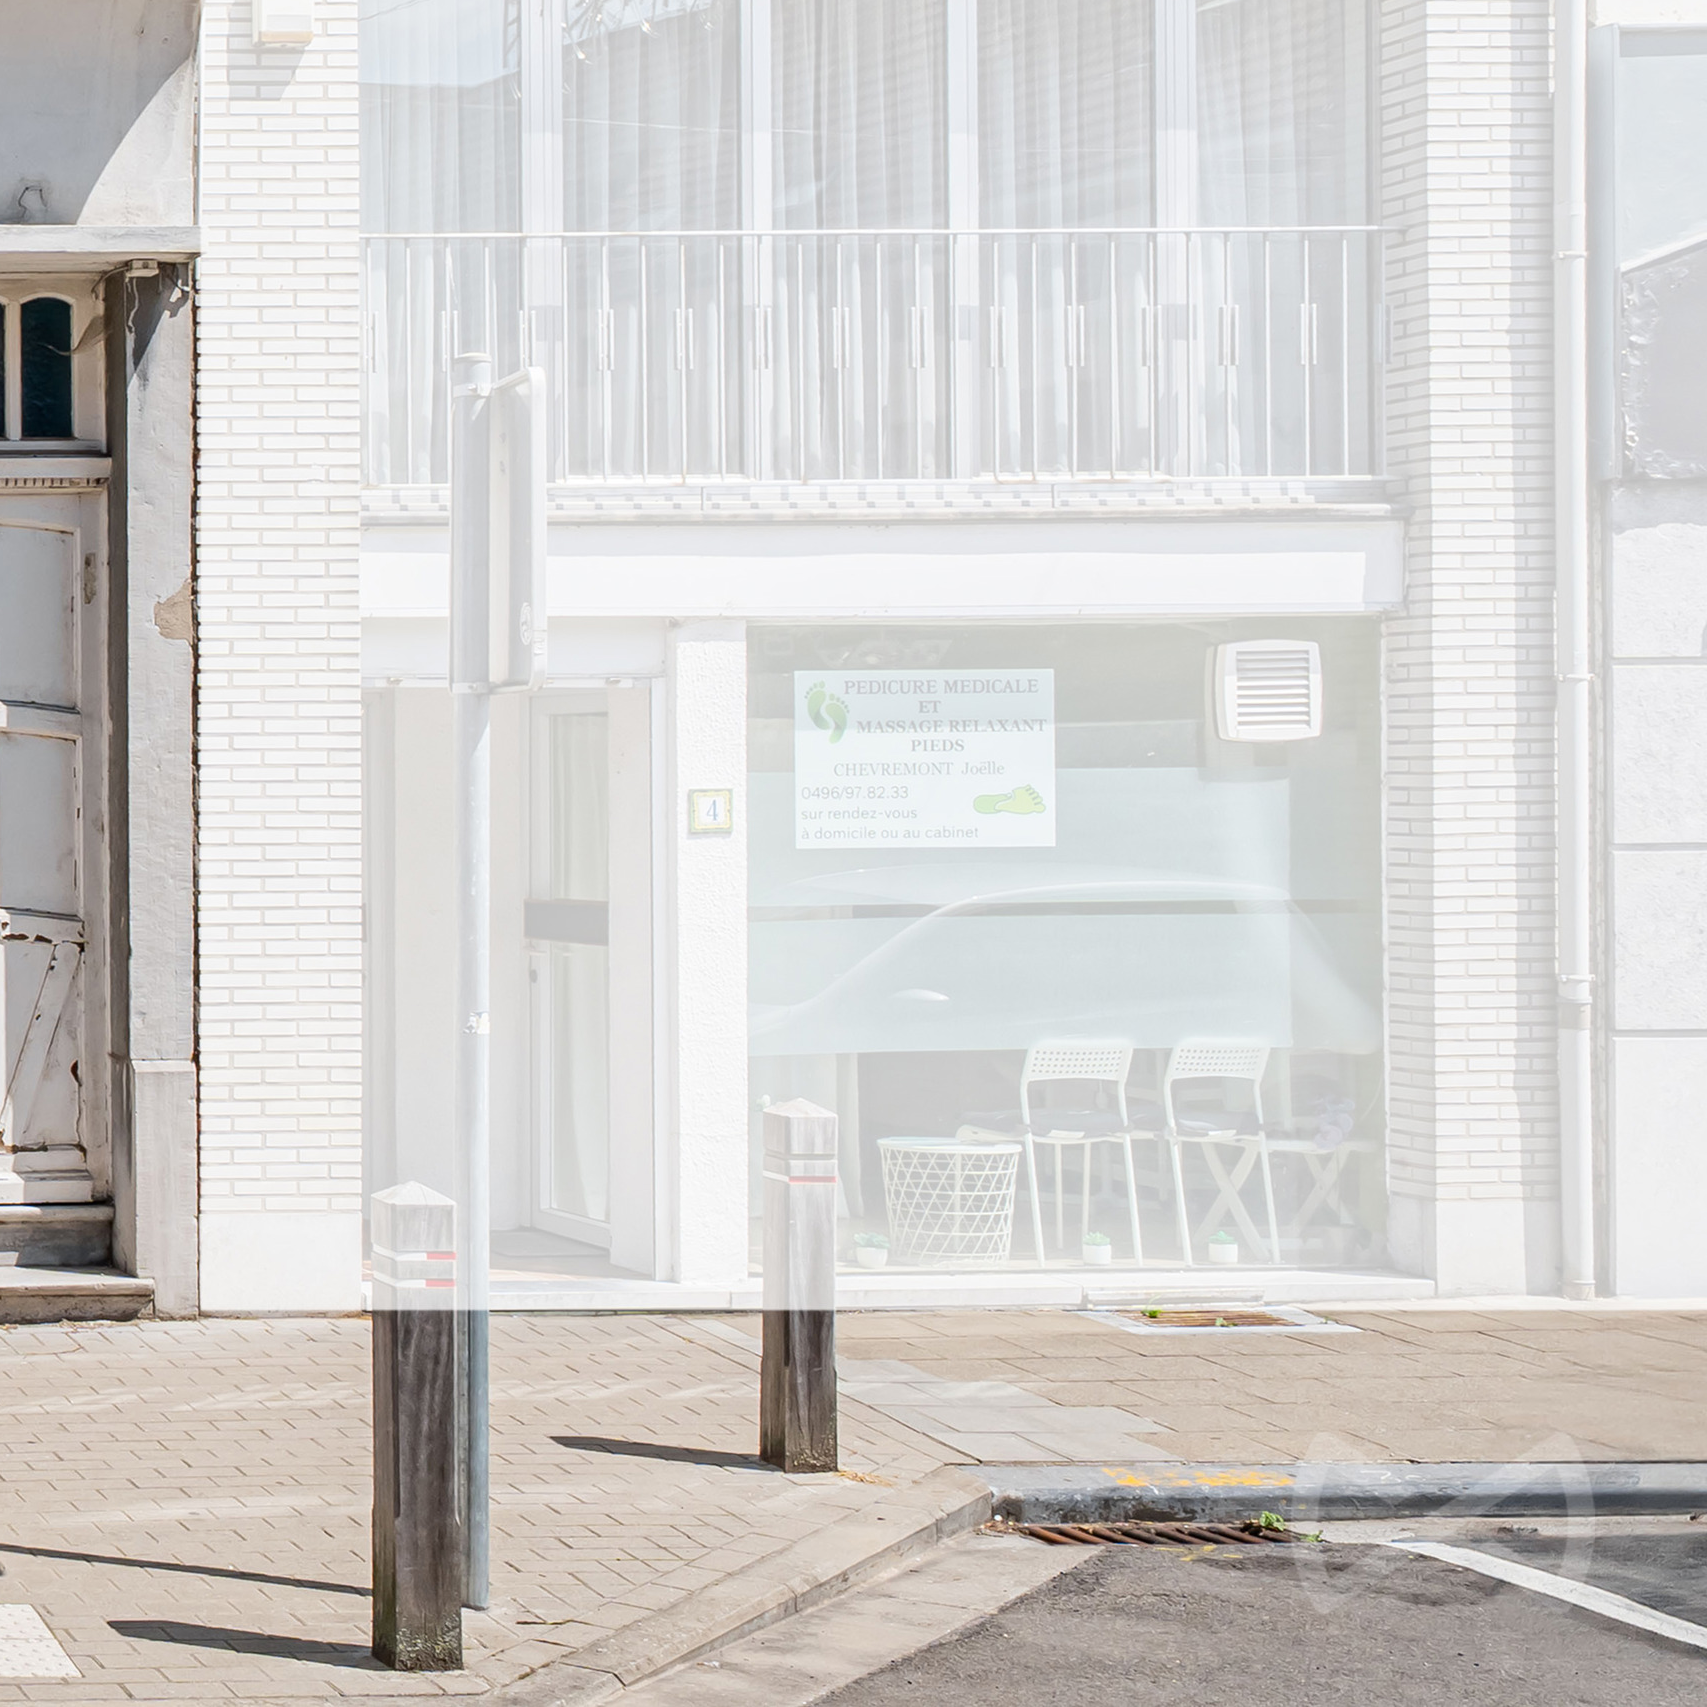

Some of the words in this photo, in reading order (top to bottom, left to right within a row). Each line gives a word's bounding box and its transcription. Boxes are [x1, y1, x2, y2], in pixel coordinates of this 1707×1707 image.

[843, 680, 938, 695] PEDICURE
[944, 679, 1039, 694] MEDICALE
[918, 700, 942, 714] ET
[857, 721, 944, 734] MASSAGE
[948, 719, 1047, 733] RELAXANT
[911, 739, 965, 752] PIEDS
[834, 762, 954, 777] CHEVREMONT
[961, 761, 1005, 776] Joëlle
[801, 785, 909, 800] 0496/97.82.33
[706, 799, 719, 821] 4
[801, 810, 823, 820] sur
[827, 806, 918, 820] rendez-vous
[801, 827, 810, 840] à
[814, 826, 876, 840] domicile
[881, 829, 899, 840] ou
[903, 829, 921, 839] au
[925, 826, 979, 839] cabinet
